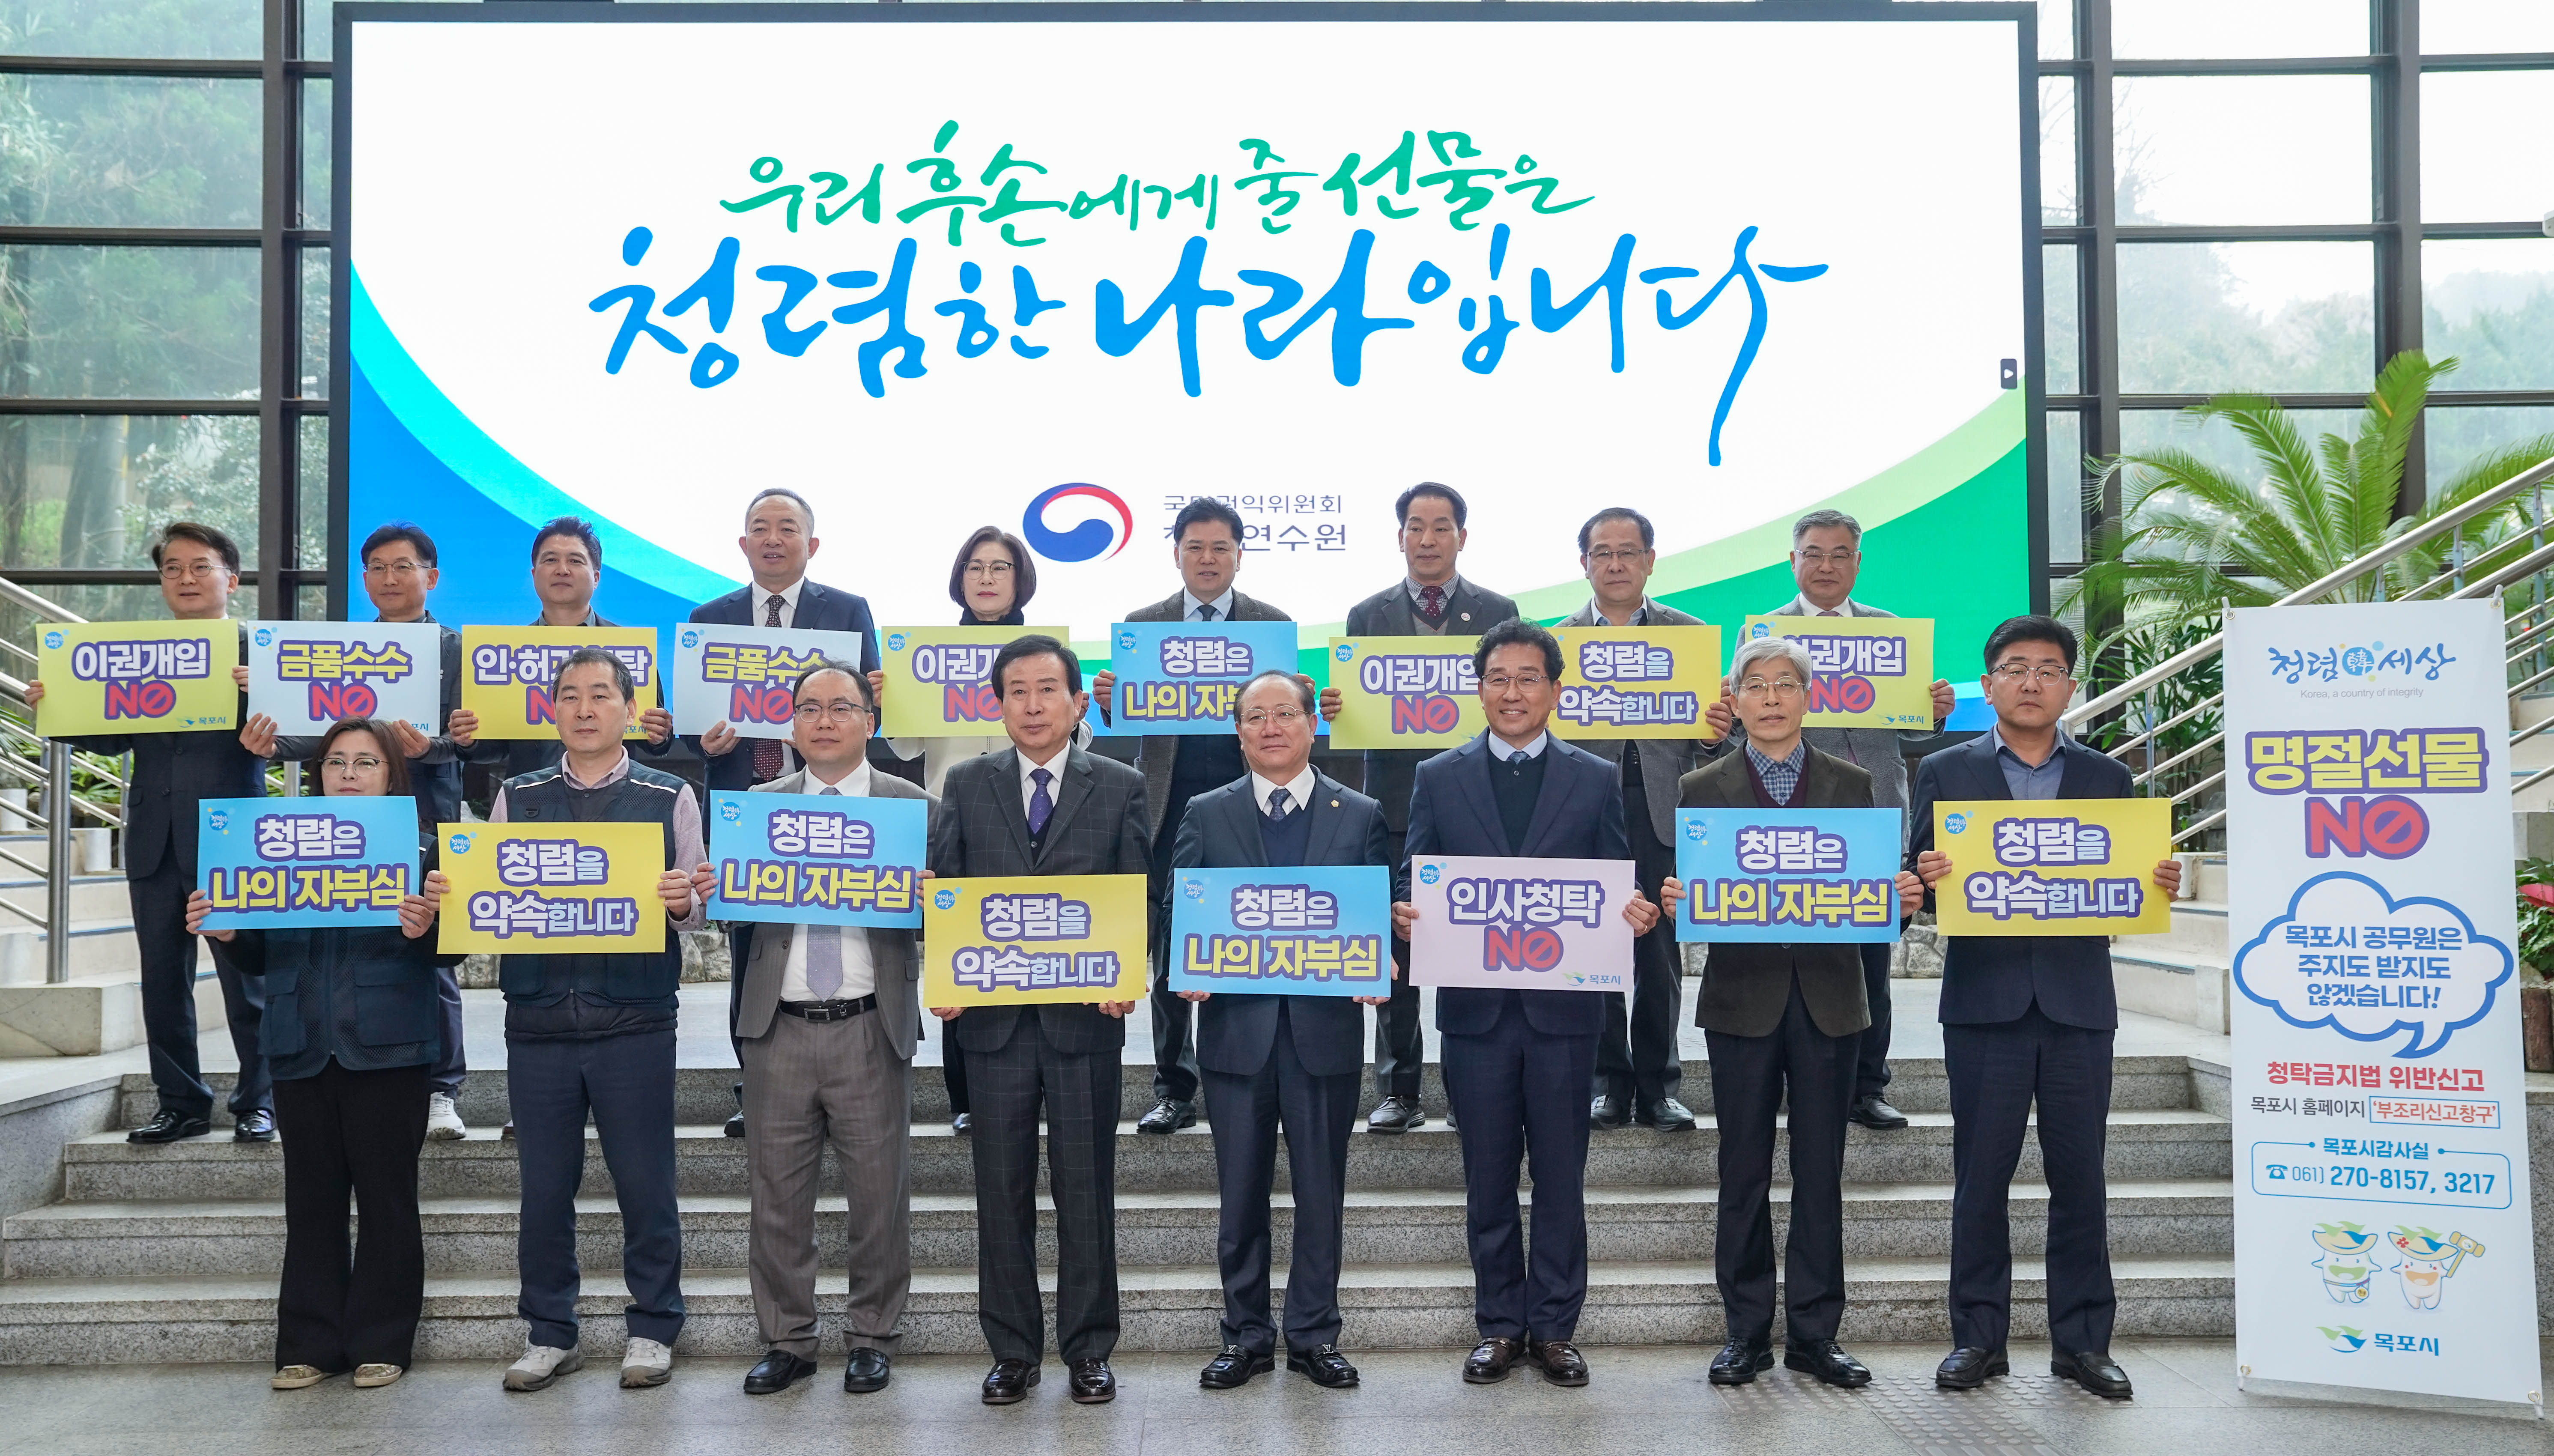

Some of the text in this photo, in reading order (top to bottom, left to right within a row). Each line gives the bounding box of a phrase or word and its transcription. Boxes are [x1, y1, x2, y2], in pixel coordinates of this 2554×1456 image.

[719, 120, 1595, 247] 우리 후손에게 줄 선물은
[588, 226, 1829, 466] 청렴한 나라입니다
[1164, 495, 1341, 513] 국익위원회
[1164, 524, 1346, 551] 연수원
[75, 642, 206, 678] 이권개입
[281, 644, 408, 679] 금품수수
[916, 648, 1000, 680] 이권
[1164, 640, 1249, 673] 청렴은
[1584, 645, 1669, 678] 청렴을
[1802, 639, 1902, 672] 권개입
[2378, 643, 2456, 680] 세상
[108, 683, 172, 716] NO
[313, 686, 373, 717] NO
[1126, 685, 1185, 717] 나의
[1559, 689, 1695, 722] 약속합니다
[1812, 678, 1872, 710] NO
[2300, 690, 2330, 698] Korea,
[2341, 689, 2374, 699] country
[2377, 689, 2386, 697] of
[2388, 687, 2423, 698] integrity
[199, 716, 226, 725] 목포시
[1396, 698, 1456, 730] NO
[1898, 715, 1924, 724] 목포시
[2252, 733, 2482, 789] 명절선물
[260, 819, 361, 856] 청렴은
[773, 814, 870, 854] 청렴은
[1999, 822, 2106, 862] 청렴을
[2309, 800, 2423, 854] NO
[501, 844, 603, 882] 청렴을
[1740, 830, 1843, 870] 청렴은
[213, 868, 404, 908] 나의 자부심
[724, 863, 910, 908] 나의 자부심
[1969, 875, 2138, 915] 약속합니다
[472, 895, 634, 934] 약속합니다
[986, 898, 1086, 937] 청렴을
[1235, 889, 1334, 926] 청렴은
[1451, 882, 1600, 923] 인사청탁
[1695, 883, 1887, 922] 나의 자부심
[1489, 930, 1559, 968] NO
[2285, 926, 2462, 950] 목포시 공무원은
[957, 950, 1115, 988] 약속합니다
[1188, 938, 1376, 977] 나의 자부심
[2298, 955, 2451, 979] 주지도 받지도
[1589, 975, 1620, 985] 목포시
[2307, 984, 2441, 1009] 않겠습니다!
[2267, 1062, 2484, 1092] 청탁금지법 위반신고
[2251, 1096, 2296, 1114] 목포시
[2302, 1098, 2365, 1118] 홈페이지
[2323, 1137, 2429, 1160] 목포시감사실
[2292, 1166, 2495, 1194] 061) 270-8157, 3217
[2374, 1333, 2440, 1356] 목포시
